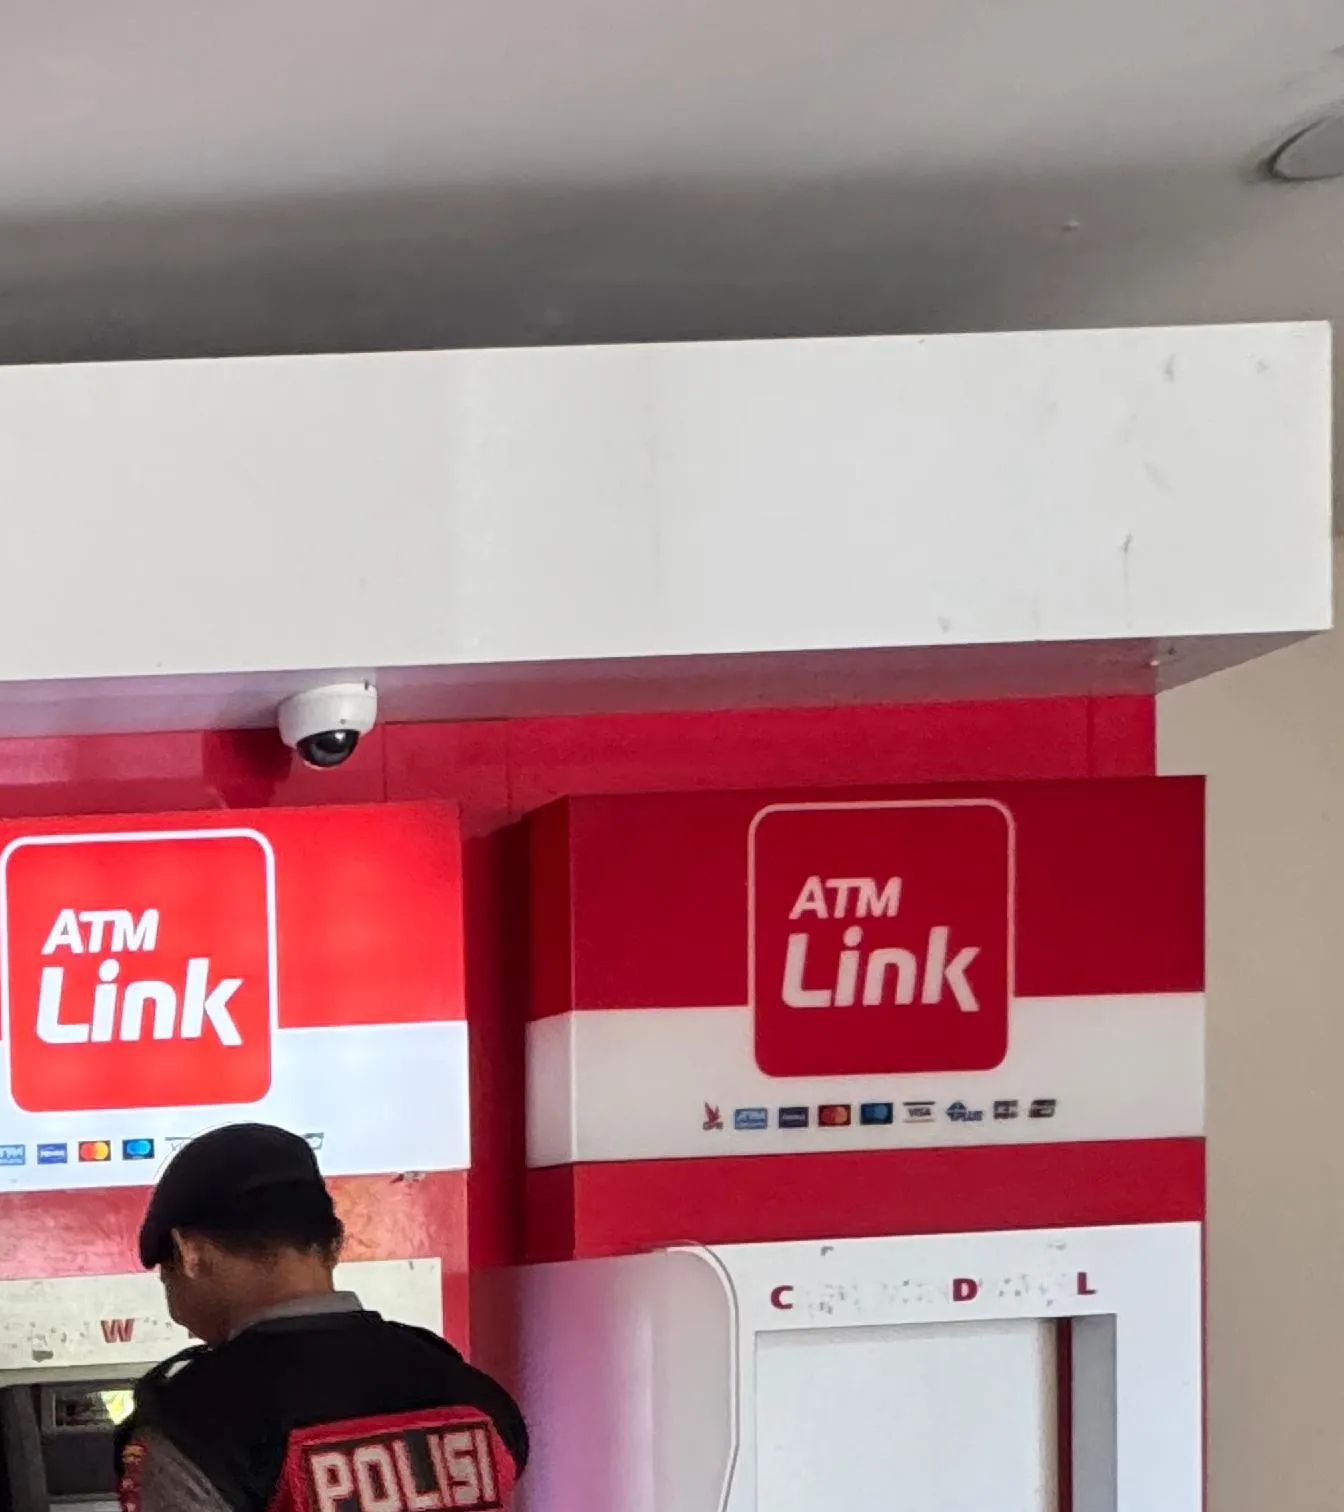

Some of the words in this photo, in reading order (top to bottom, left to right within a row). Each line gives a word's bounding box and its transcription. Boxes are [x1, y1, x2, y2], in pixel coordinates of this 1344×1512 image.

[788, 875, 902, 920] ATM
[41, 908, 160, 955] ATM
[781, 925, 980, 1012] Link
[36, 957, 243, 1046] Link
[770, 1285, 794, 1310] C
[952, 1278, 978, 1302] D
[1077, 1271, 1097, 1296] L
[100, 1318, 134, 1344] W
